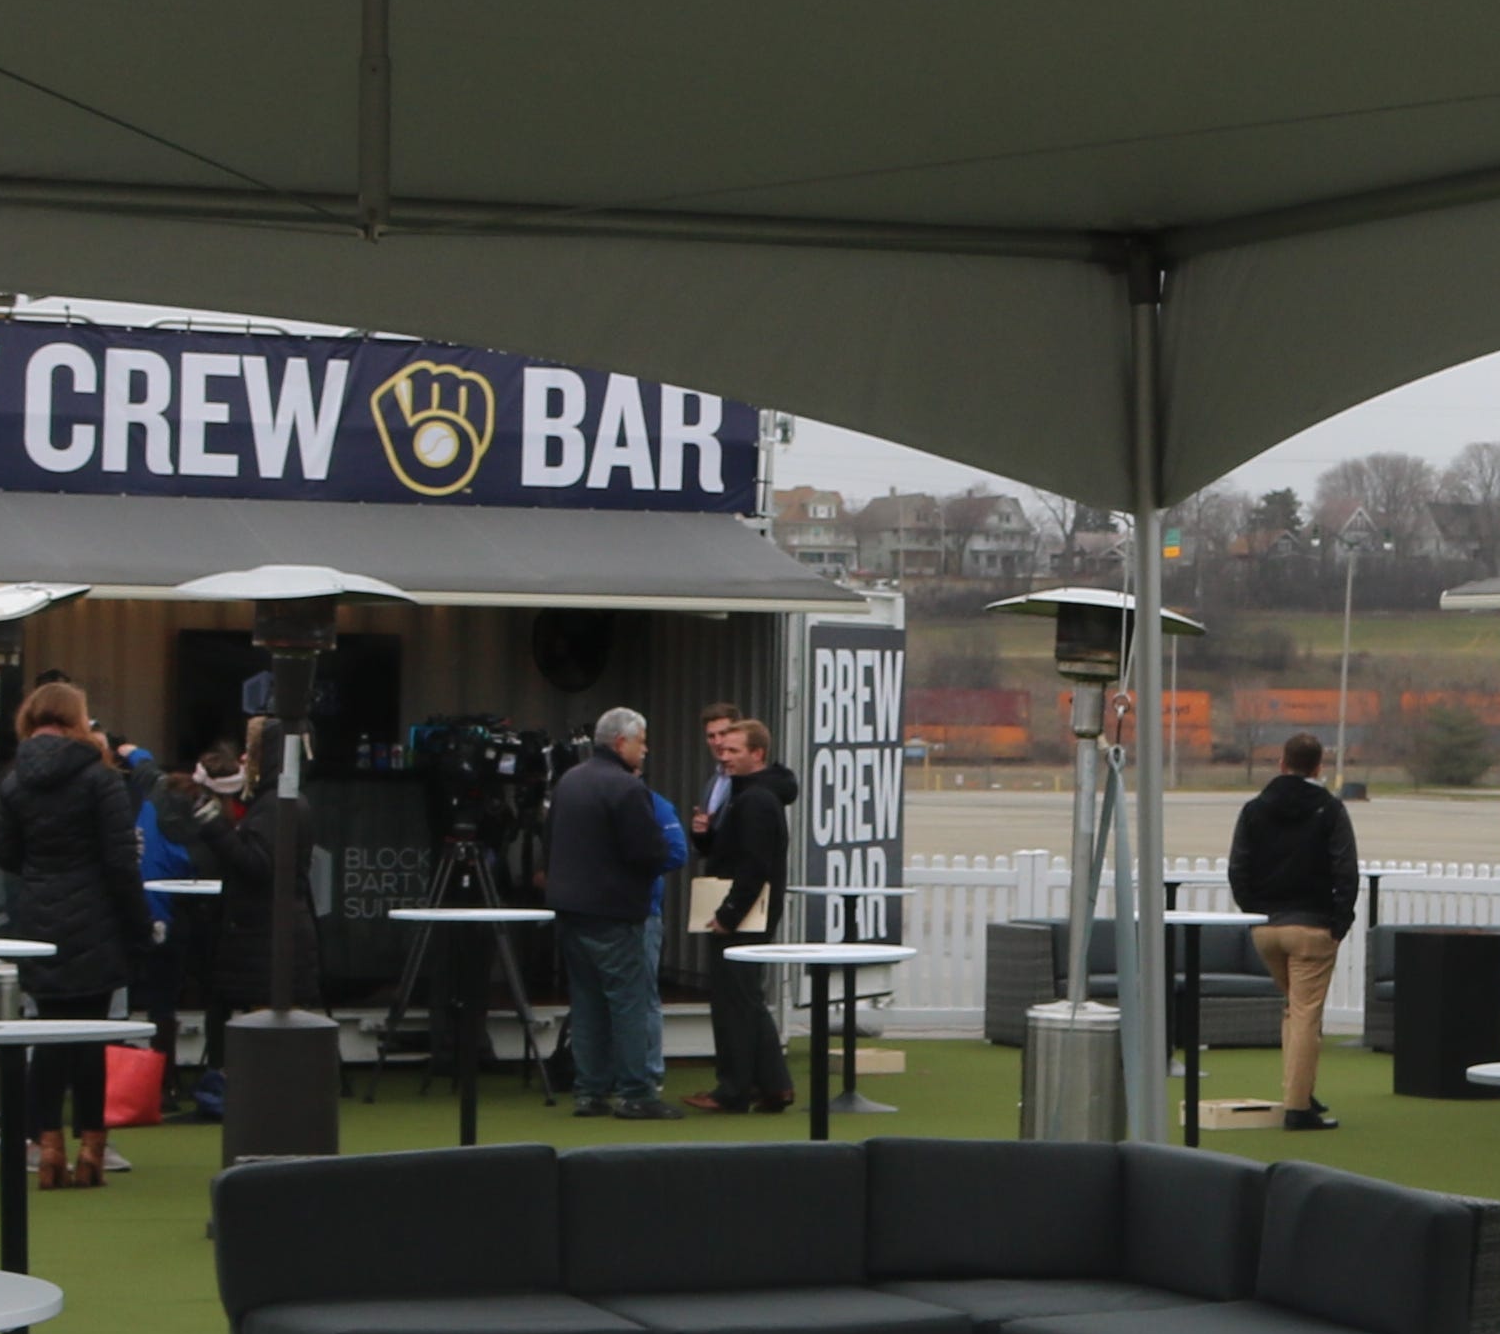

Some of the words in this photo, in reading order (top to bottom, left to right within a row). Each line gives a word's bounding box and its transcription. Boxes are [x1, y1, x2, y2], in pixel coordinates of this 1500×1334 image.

[24, 343, 350, 480] CREW
[521, 367, 725, 495] BAR
[814, 648, 905, 744] BREW
[812, 747, 903, 847] CREW
[343, 872, 430, 893] PARTY
[344, 847, 431, 870] BLOCK
[825, 846, 887, 945] BAR
